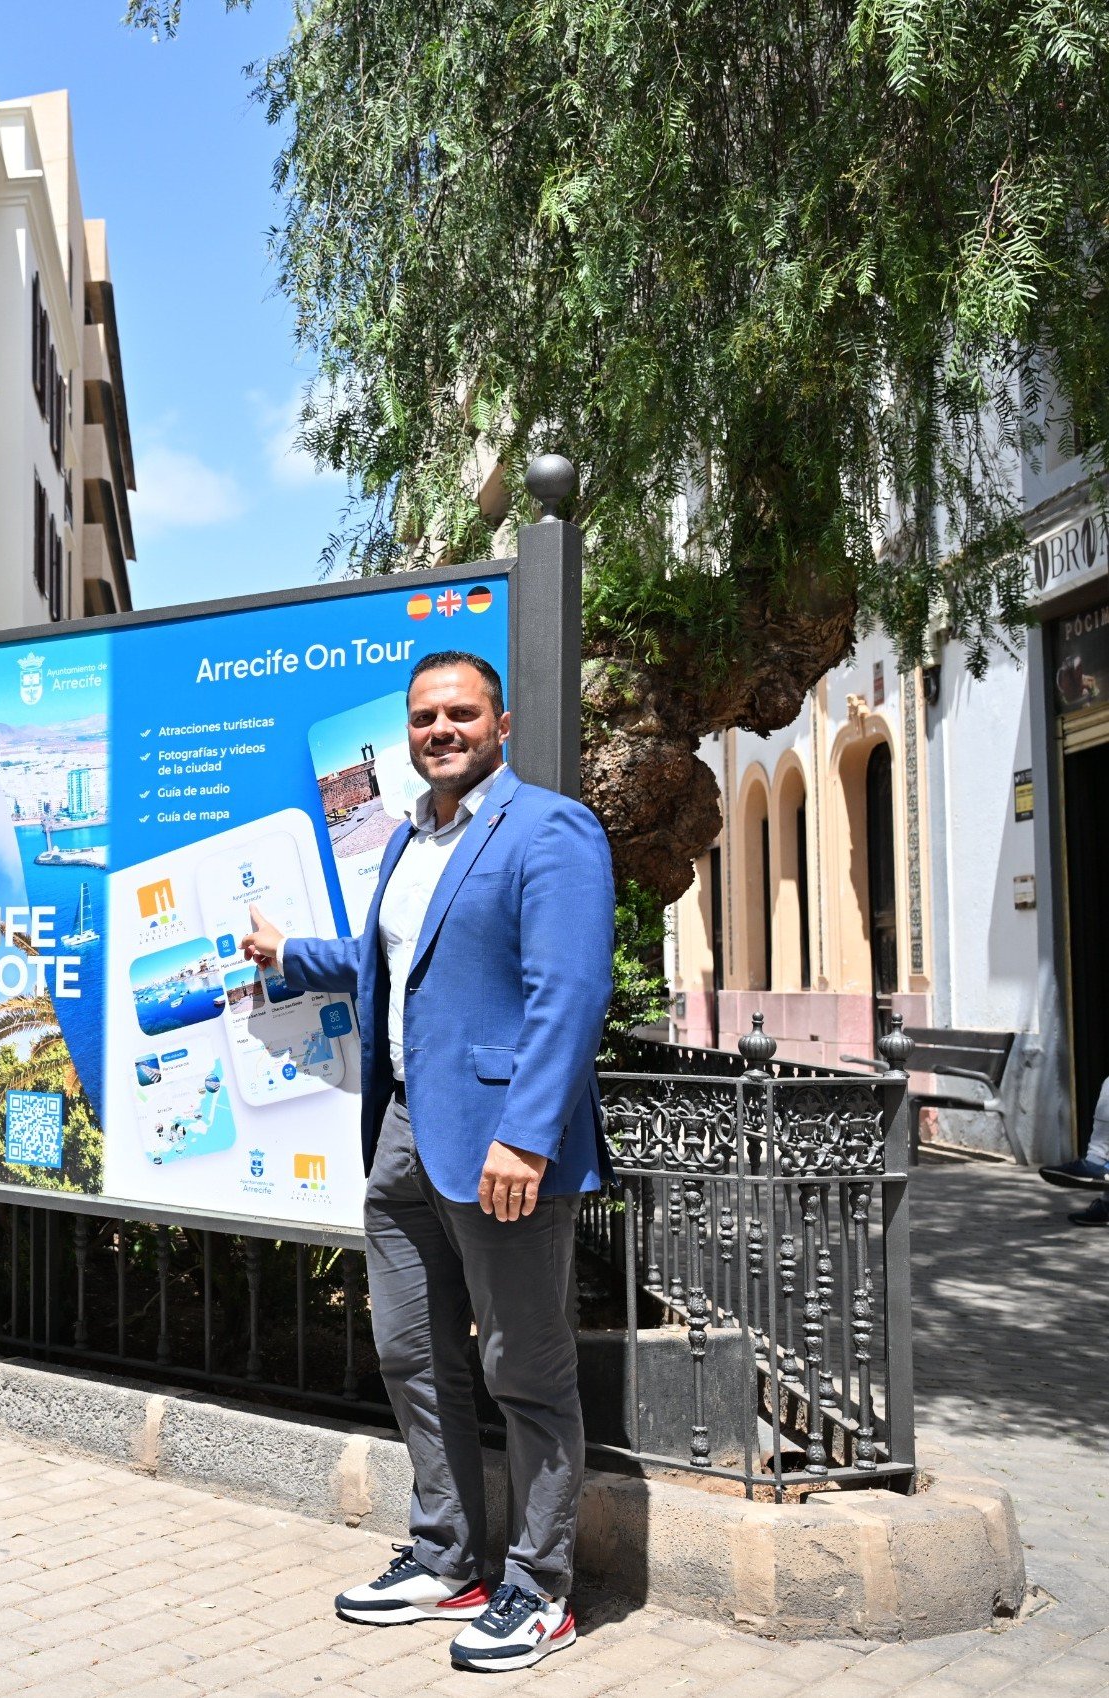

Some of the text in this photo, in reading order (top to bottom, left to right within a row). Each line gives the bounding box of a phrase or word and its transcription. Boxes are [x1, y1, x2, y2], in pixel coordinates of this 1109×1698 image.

[196, 638, 415, 683] Arrecife On Tour
[47, 662, 108, 677] Ayuntamiento de
[52, 674, 102, 691] Arrecife
[158, 717, 275, 737] Atracciones turísticas
[158, 743, 266, 761] Fotografías y videos
[158, 761, 222, 776] de la ciudad
[157, 783, 230, 798] Guía de audio
[157, 809, 230, 823] Guía de mapa
[243, 1185, 272, 1194] Arrecife
